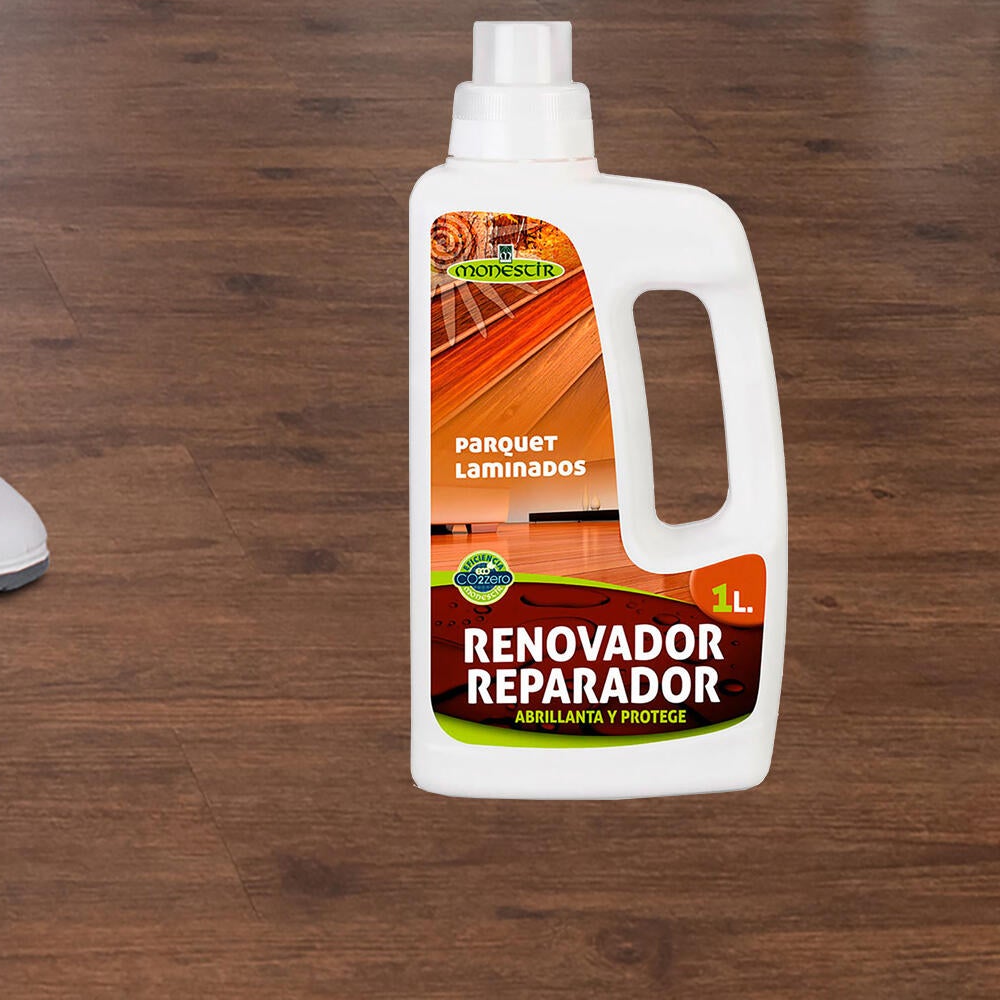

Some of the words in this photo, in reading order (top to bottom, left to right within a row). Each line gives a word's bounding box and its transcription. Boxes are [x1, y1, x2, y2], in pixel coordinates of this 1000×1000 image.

[463, 623, 725, 664] RENOVADOR
[467, 665, 721, 705] REPARADOR
[514, 710, 604, 724] ABRILLANTA
[607, 710, 618, 724] Y
[620, 709, 687, 724] PROTEGE
